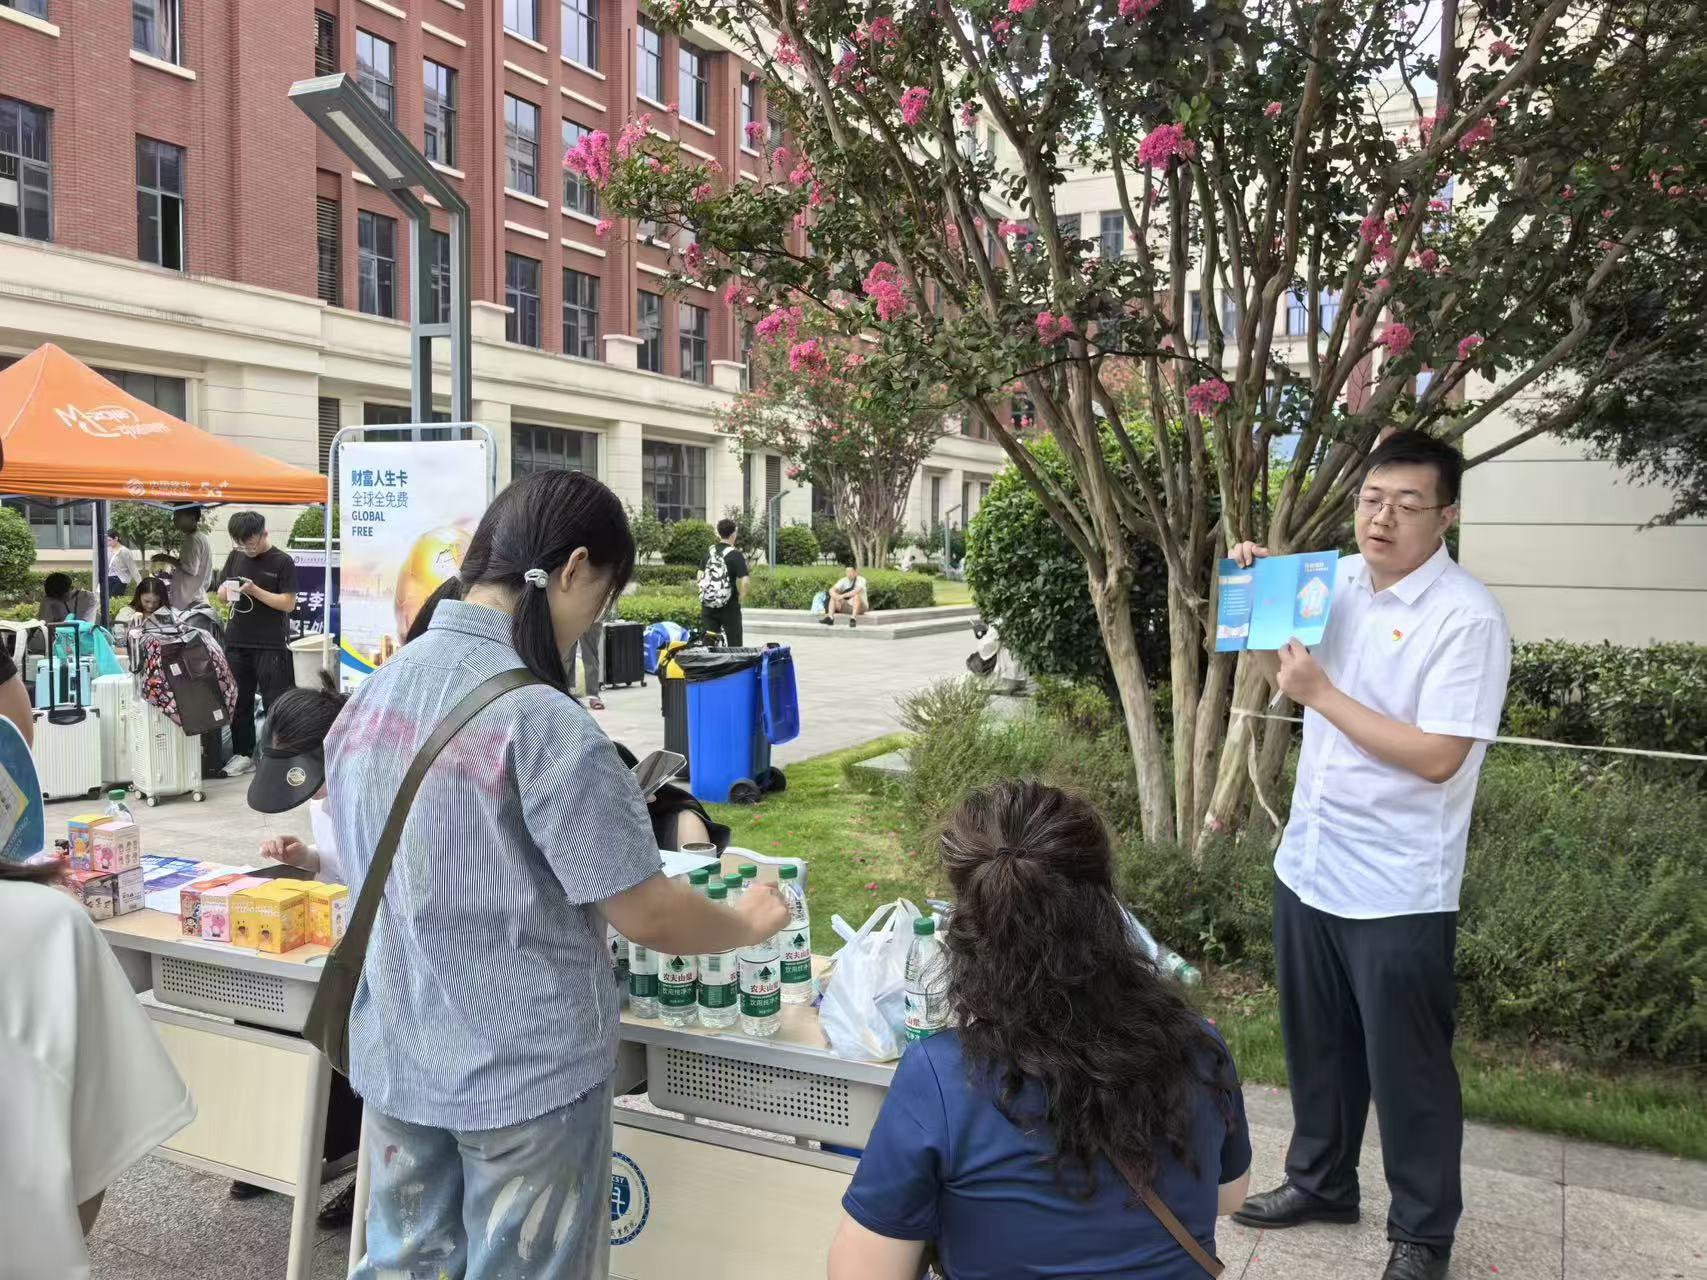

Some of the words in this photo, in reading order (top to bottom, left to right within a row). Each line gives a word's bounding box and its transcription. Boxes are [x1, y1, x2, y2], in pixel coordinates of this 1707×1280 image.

[351, 469, 408, 487] 财富人生卡
[352, 491, 408, 508] 全球全免费
[351, 510, 386, 521] GLOBAL
[351, 526, 373, 537] FREE
